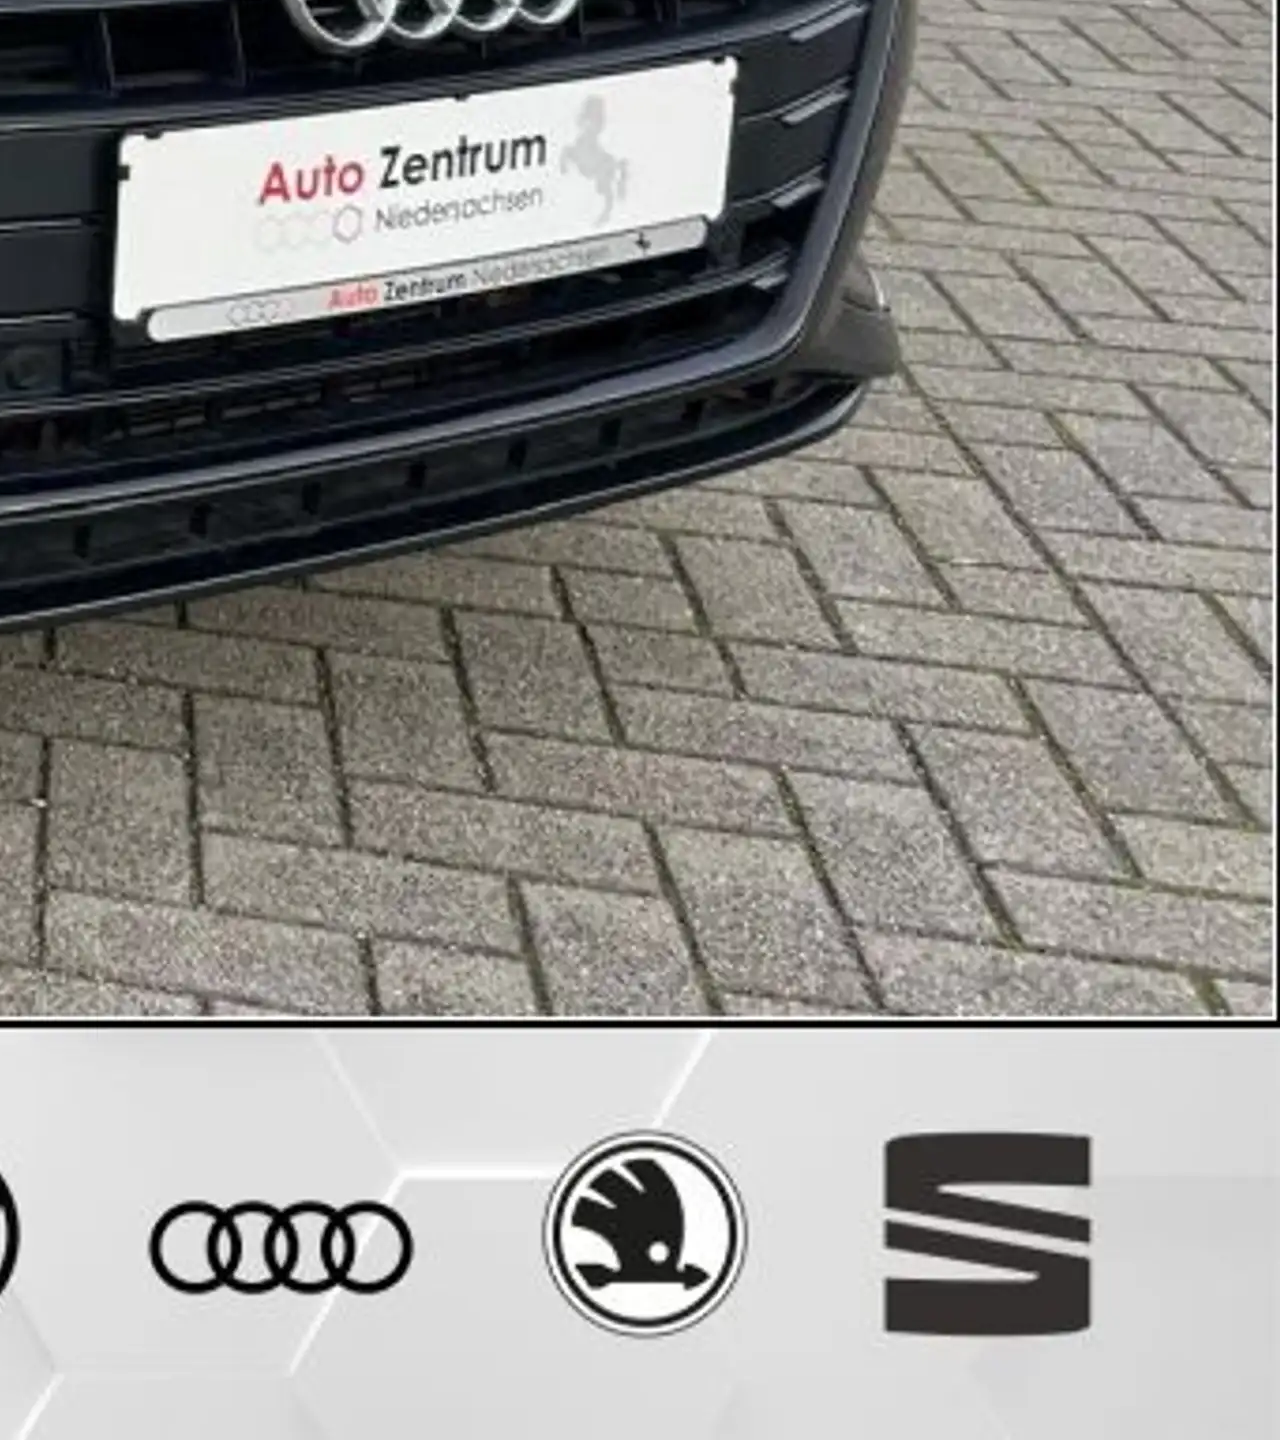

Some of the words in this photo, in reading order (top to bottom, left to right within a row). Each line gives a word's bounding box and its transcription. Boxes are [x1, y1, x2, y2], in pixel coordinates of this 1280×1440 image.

[259, 155, 365, 205] Auto
[378, 133, 547, 189] Zentrum
[373, 186, 544, 233] Niedersachsen
[327, 281, 379, 310] Auto
[383, 270, 468, 302] Zentrum
